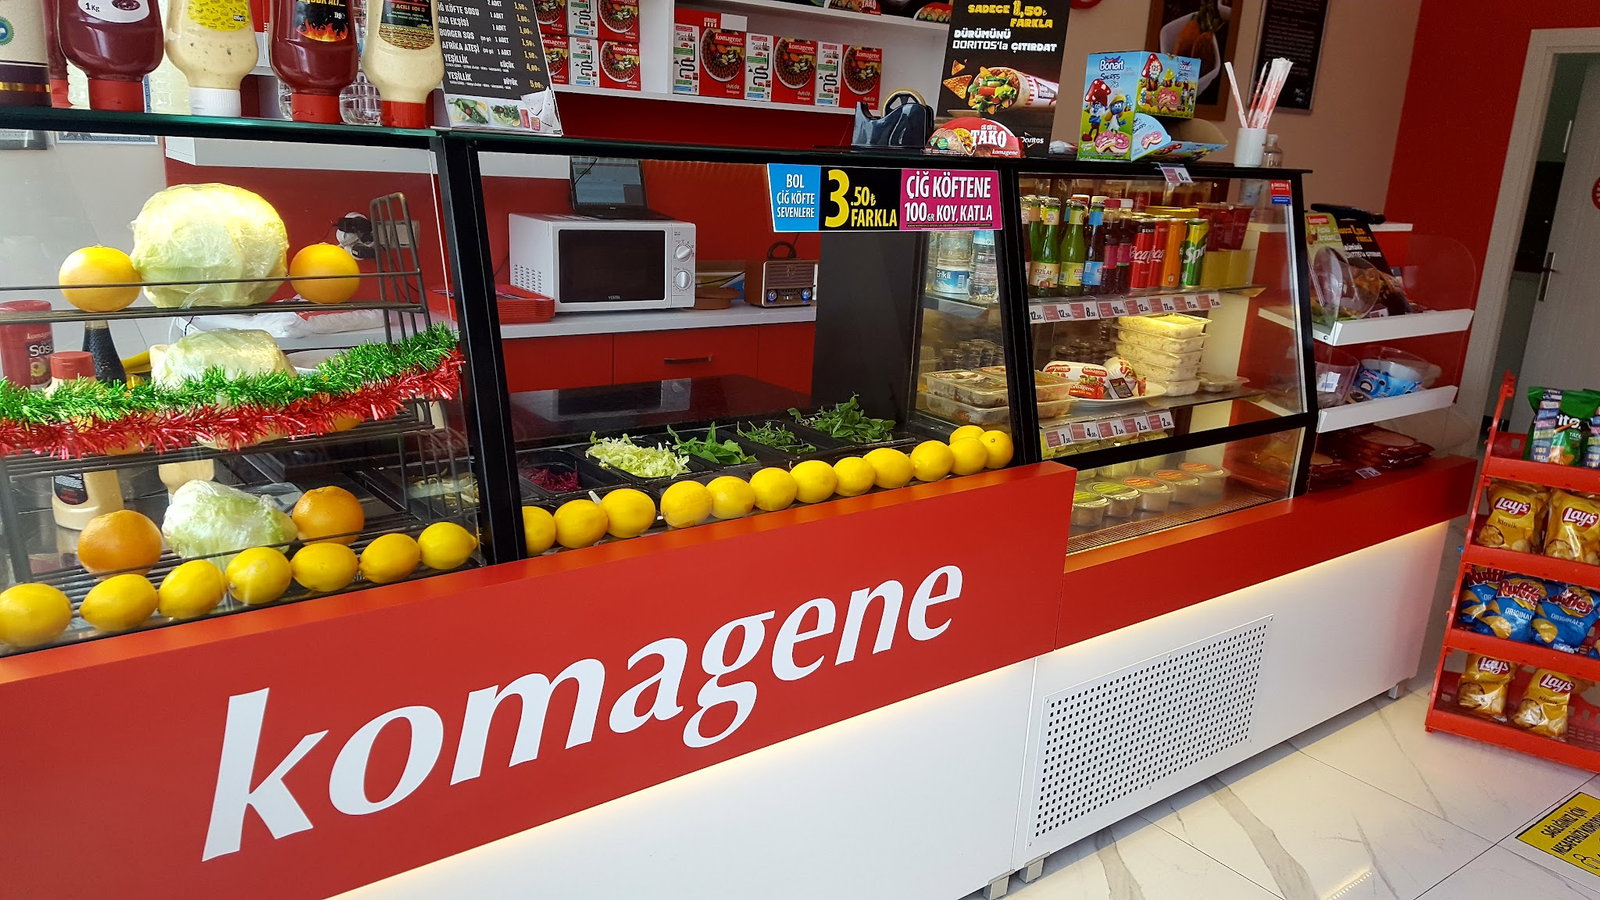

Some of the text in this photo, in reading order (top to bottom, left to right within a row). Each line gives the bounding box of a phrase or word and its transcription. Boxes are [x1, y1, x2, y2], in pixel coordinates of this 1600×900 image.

[445, 4, 463, 14] KÖFTE
[968, 4, 1010, 13] SADECE
[1010, 18, 1053, 28] FARKLA
[954, 28, 1011, 39] DÜRÜMÜNÜ
[442, 41, 463, 51] AFRİKA
[464, 43, 480, 54] ATEŞİ
[953, 40, 1057, 53] DORITOS'la ÇITIRDAT
[444, 54, 469, 64] YEŞİLLİK
[447, 71, 472, 82] YEŞİLLİK
[970, 129, 1007, 148] TAKO
[786, 174, 804, 188] BOL
[906, 170, 991, 199] ÇİĞ KÖFTENE
[776, 190, 815, 206] ÇİĞ KÖFTE
[776, 208, 815, 218] SEVENLERE
[851, 209, 897, 227] FARKLA
[936, 203, 959, 223] KOY,
[960, 205, 993, 221] KATLA
[1496, 498, 1530, 515] Lay's
[1563, 507, 1598, 526] Lay's
[1479, 658, 1509, 674] Lay's
[1541, 673, 1574, 692] Lay's
[201, 566, 963, 863] komagene
